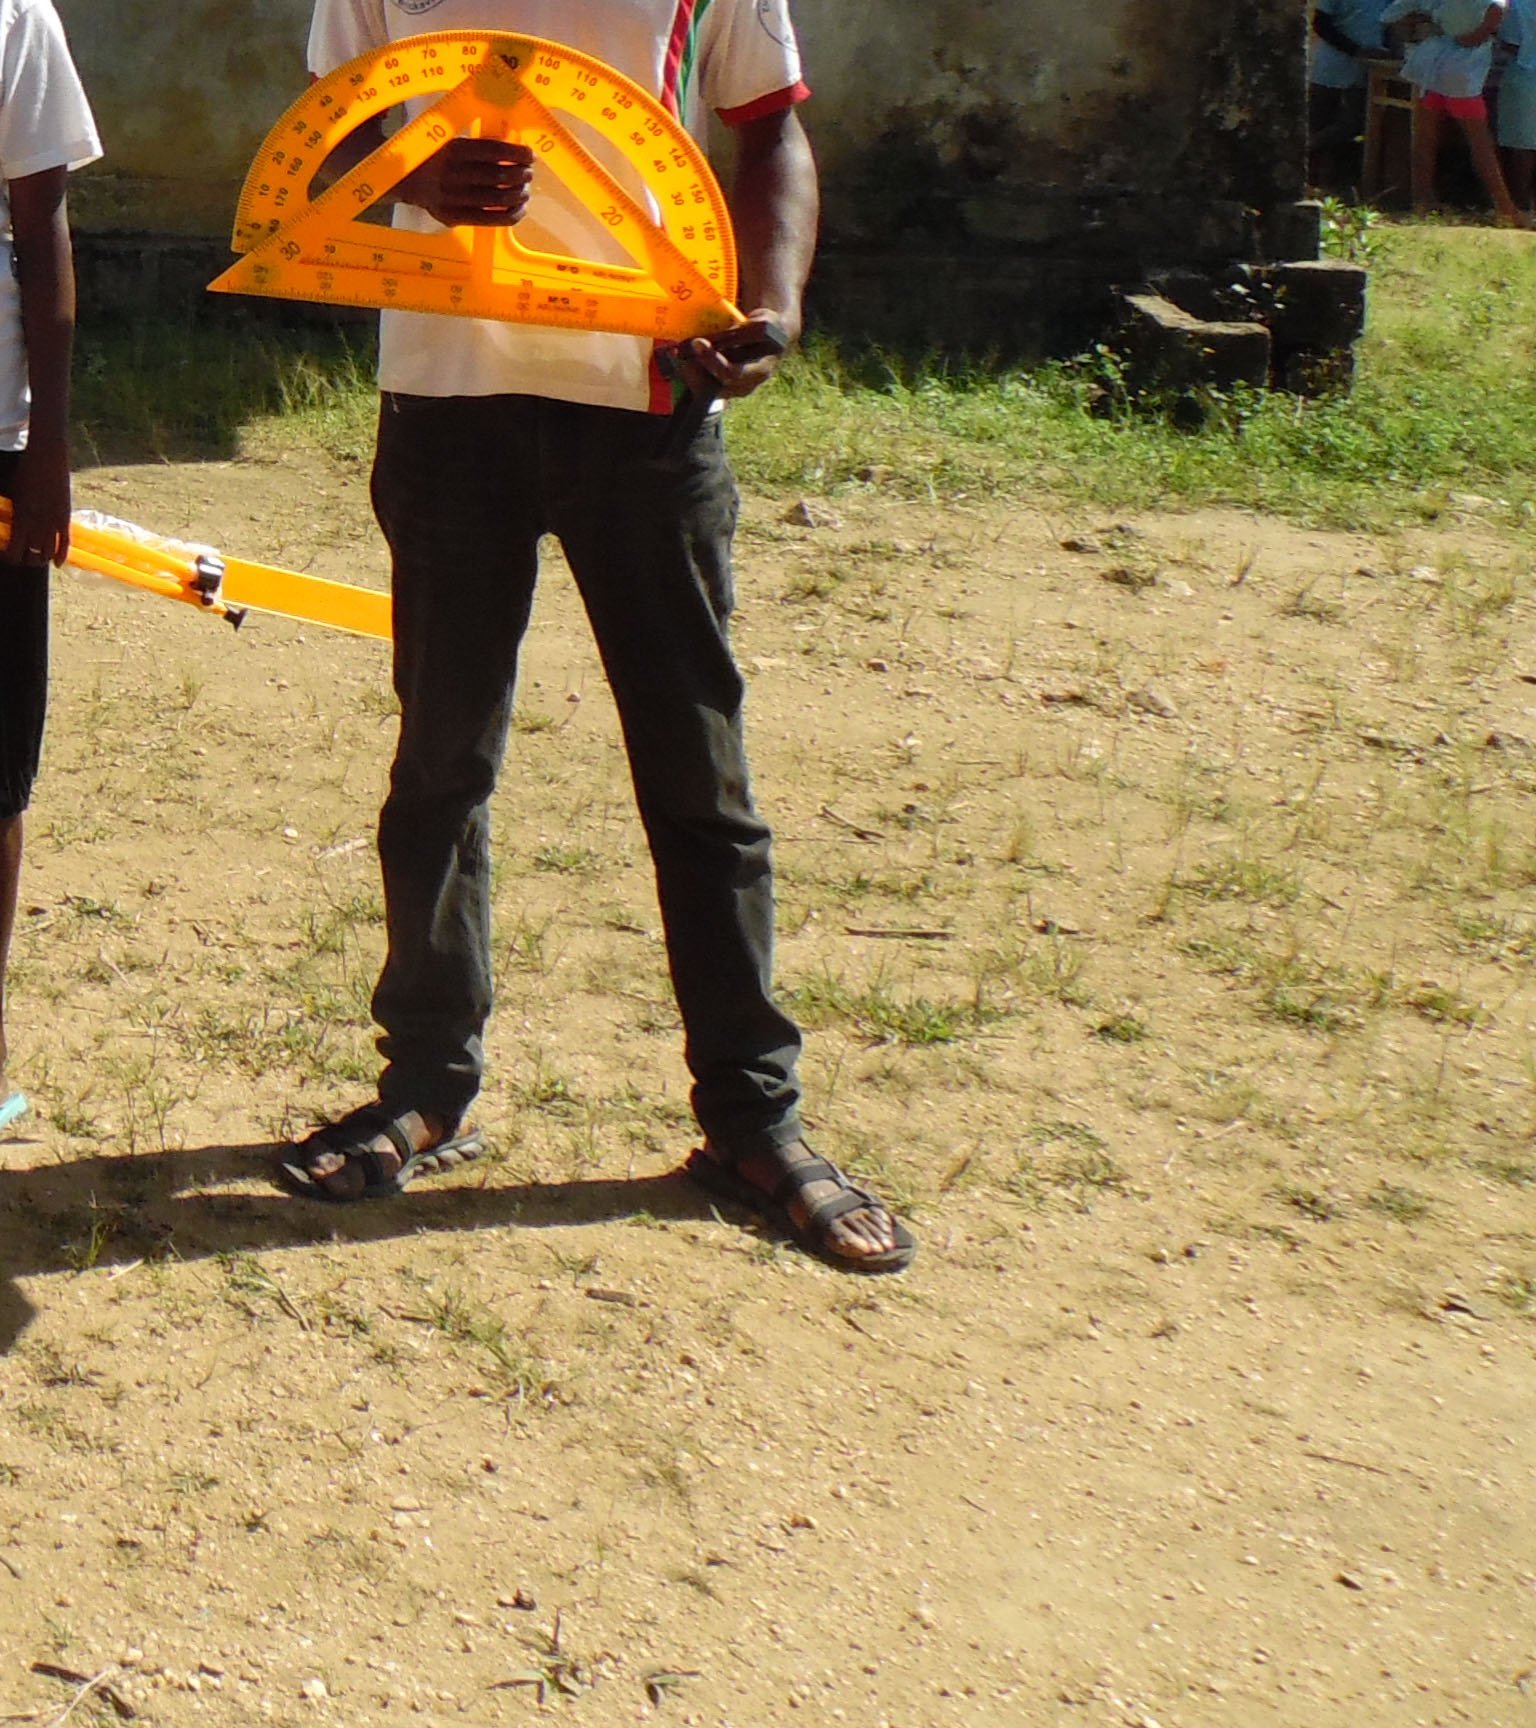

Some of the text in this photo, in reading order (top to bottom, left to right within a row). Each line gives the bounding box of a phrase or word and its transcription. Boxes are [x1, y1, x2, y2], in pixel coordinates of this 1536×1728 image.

[422, 48, 437, 59] 70
[462, 46, 477, 56] 80
[384, 57, 399, 70] 60
[539, 56, 561, 70] 100
[349, 74, 364, 87] 50
[576, 70, 598, 87] 110
[320, 95, 334, 108] 40
[611, 92, 633, 110] 120
[293, 122, 307, 134] 30
[643, 117, 663, 137] 130
[272, 151, 286, 165] 20
[275, 187, 289, 208] 170
[287, 158, 303, 177] 160
[305, 130, 322, 149] 150
[329, 106, 348, 124] 140
[357, 87, 377, 103] 130
[389, 73, 410, 88] 120
[422, 66, 444, 78] 110
[535, 73, 550, 86] 80
[570, 88, 585, 101] 70
[601, 107, 617, 121] 60
[630, 132, 645, 146] 50
[653, 159, 667, 173] 40
[671, 192, 685, 206] 30
[682, 226, 695, 240] 20
[259, 184, 270, 196] 10
[280, 124, 446, 261] 10 20 30
[689, 183, 705, 204] 150
[535, 133, 692, 301] 10 20 30
[703, 221, 716, 241] 160
[708, 259, 719, 280] 170
